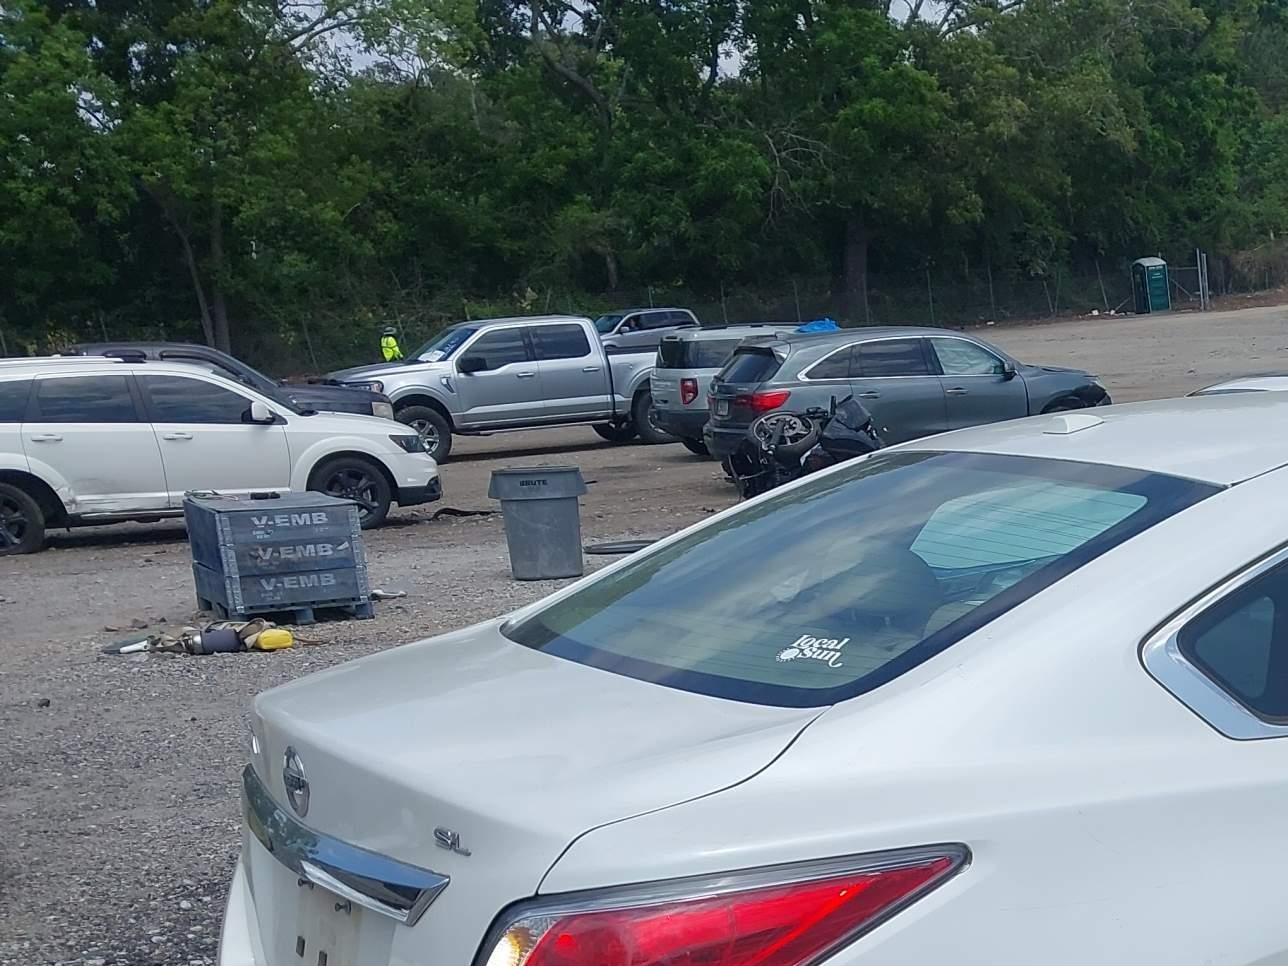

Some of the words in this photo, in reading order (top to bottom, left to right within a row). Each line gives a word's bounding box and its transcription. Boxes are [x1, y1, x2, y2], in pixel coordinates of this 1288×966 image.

[250, 512, 329, 528] V-EMB
[257, 543, 334, 561] V-EMB
[260, 573, 337, 591] V-EMB
[791, 634, 850, 650] Local
[797, 646, 844, 668] Sun
[433, 828, 472, 857] SL
